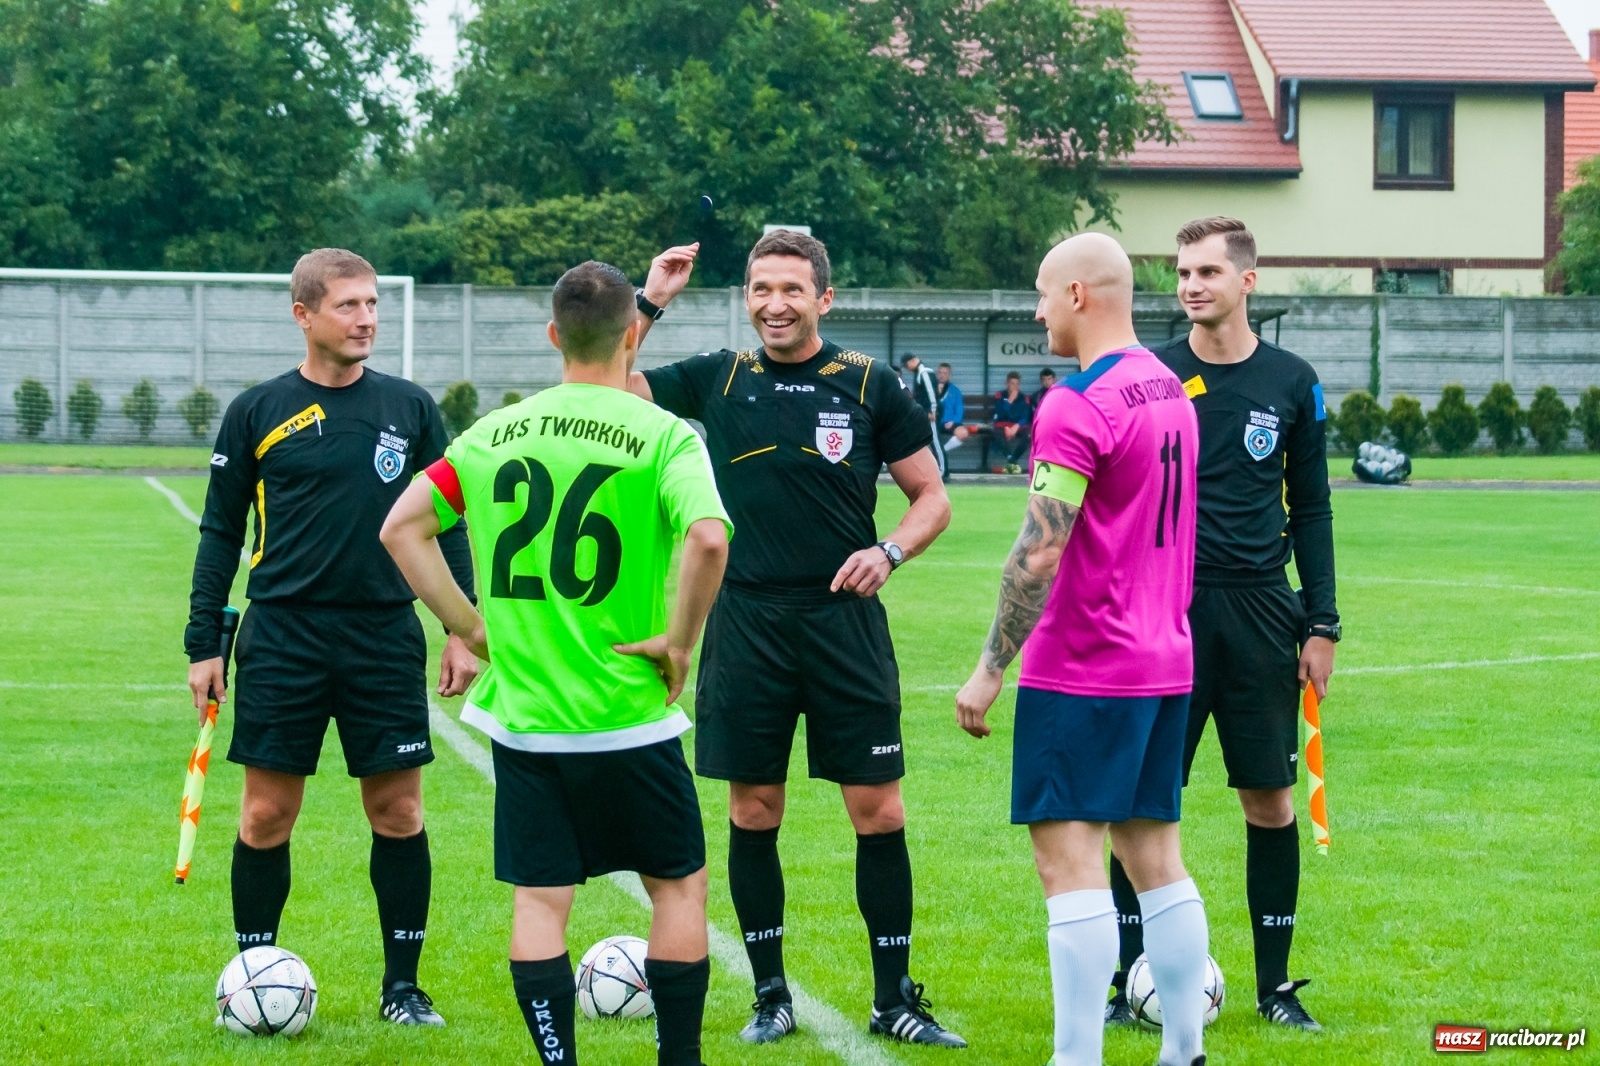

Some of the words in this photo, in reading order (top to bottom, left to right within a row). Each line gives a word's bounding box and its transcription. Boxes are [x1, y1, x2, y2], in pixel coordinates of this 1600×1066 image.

[1000, 338, 1050, 356] GOŚC
[774, 382, 816, 393] zina
[1119, 382, 1147, 409] LKS
[818, 411, 850, 421] KOLEGIUM
[819, 419, 849, 428] SĘDZIÓW
[490, 418, 531, 448] LKS
[539, 416, 646, 459] TWORKÓW
[1033, 462, 1051, 491] C
[1155, 430, 1182, 548] 11
[489, 455, 627, 607] 26
[394, 929, 427, 940] zin
[745, 926, 783, 942] zina
